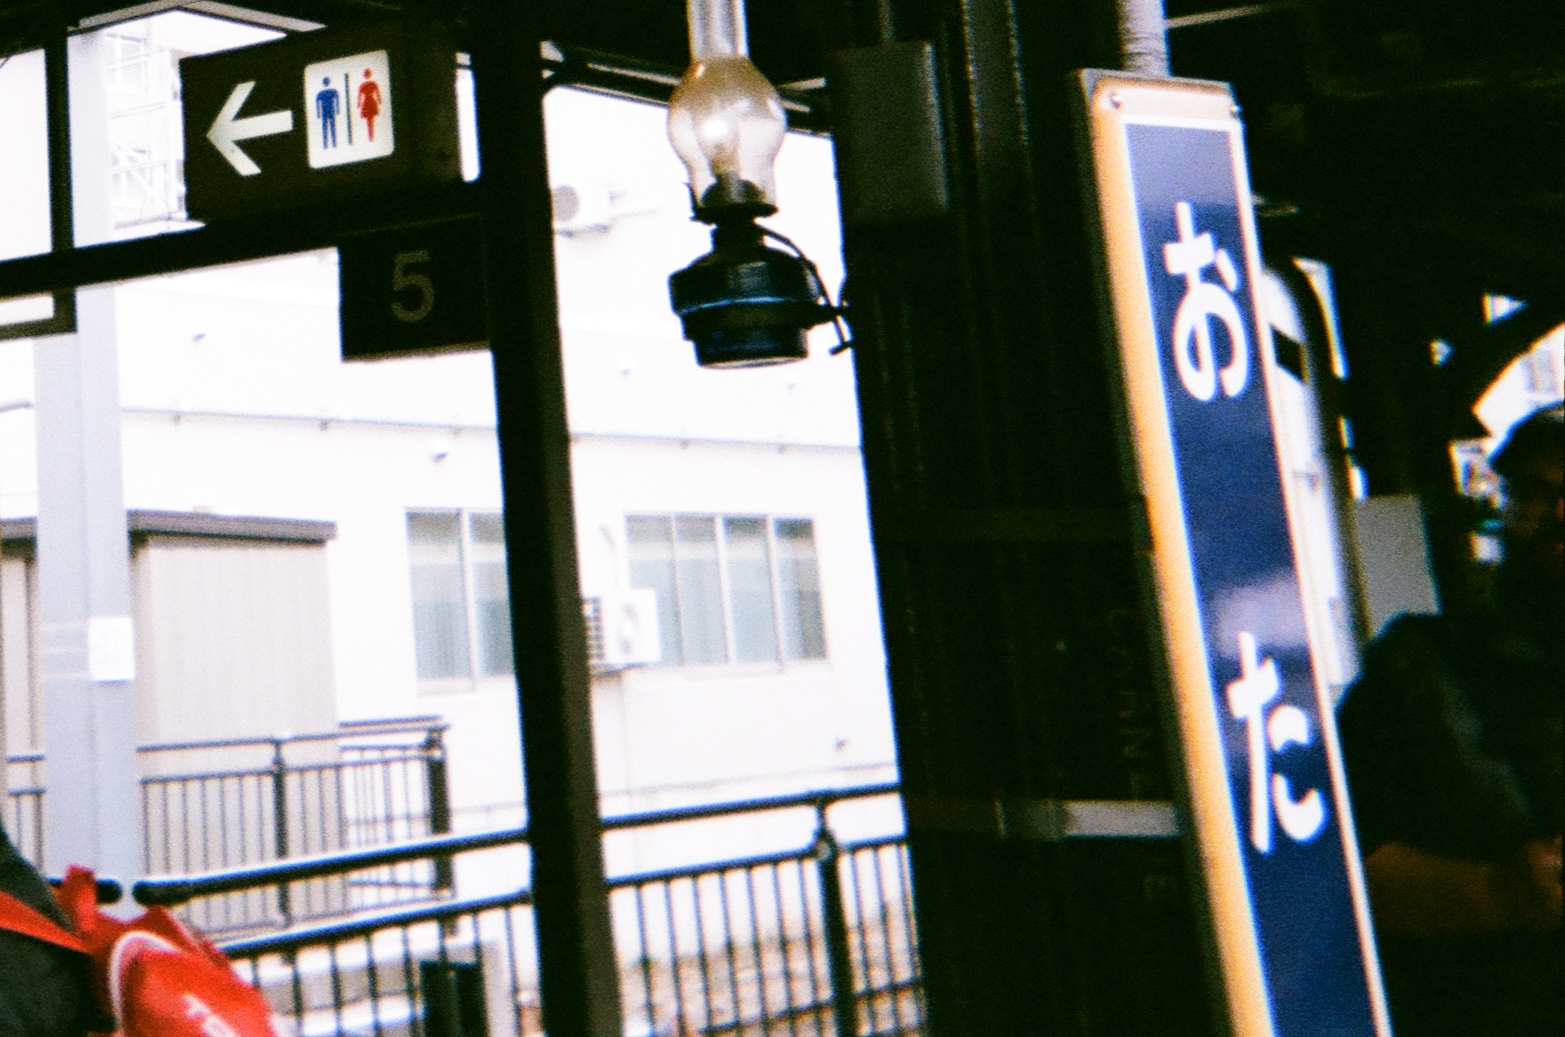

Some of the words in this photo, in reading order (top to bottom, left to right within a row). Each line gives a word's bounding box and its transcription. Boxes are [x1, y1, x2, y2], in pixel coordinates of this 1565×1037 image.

[390, 251, 436, 323] 5
[1163, 201, 1327, 854] おた
[1106, 606, 1179, 903] CARNEIE
